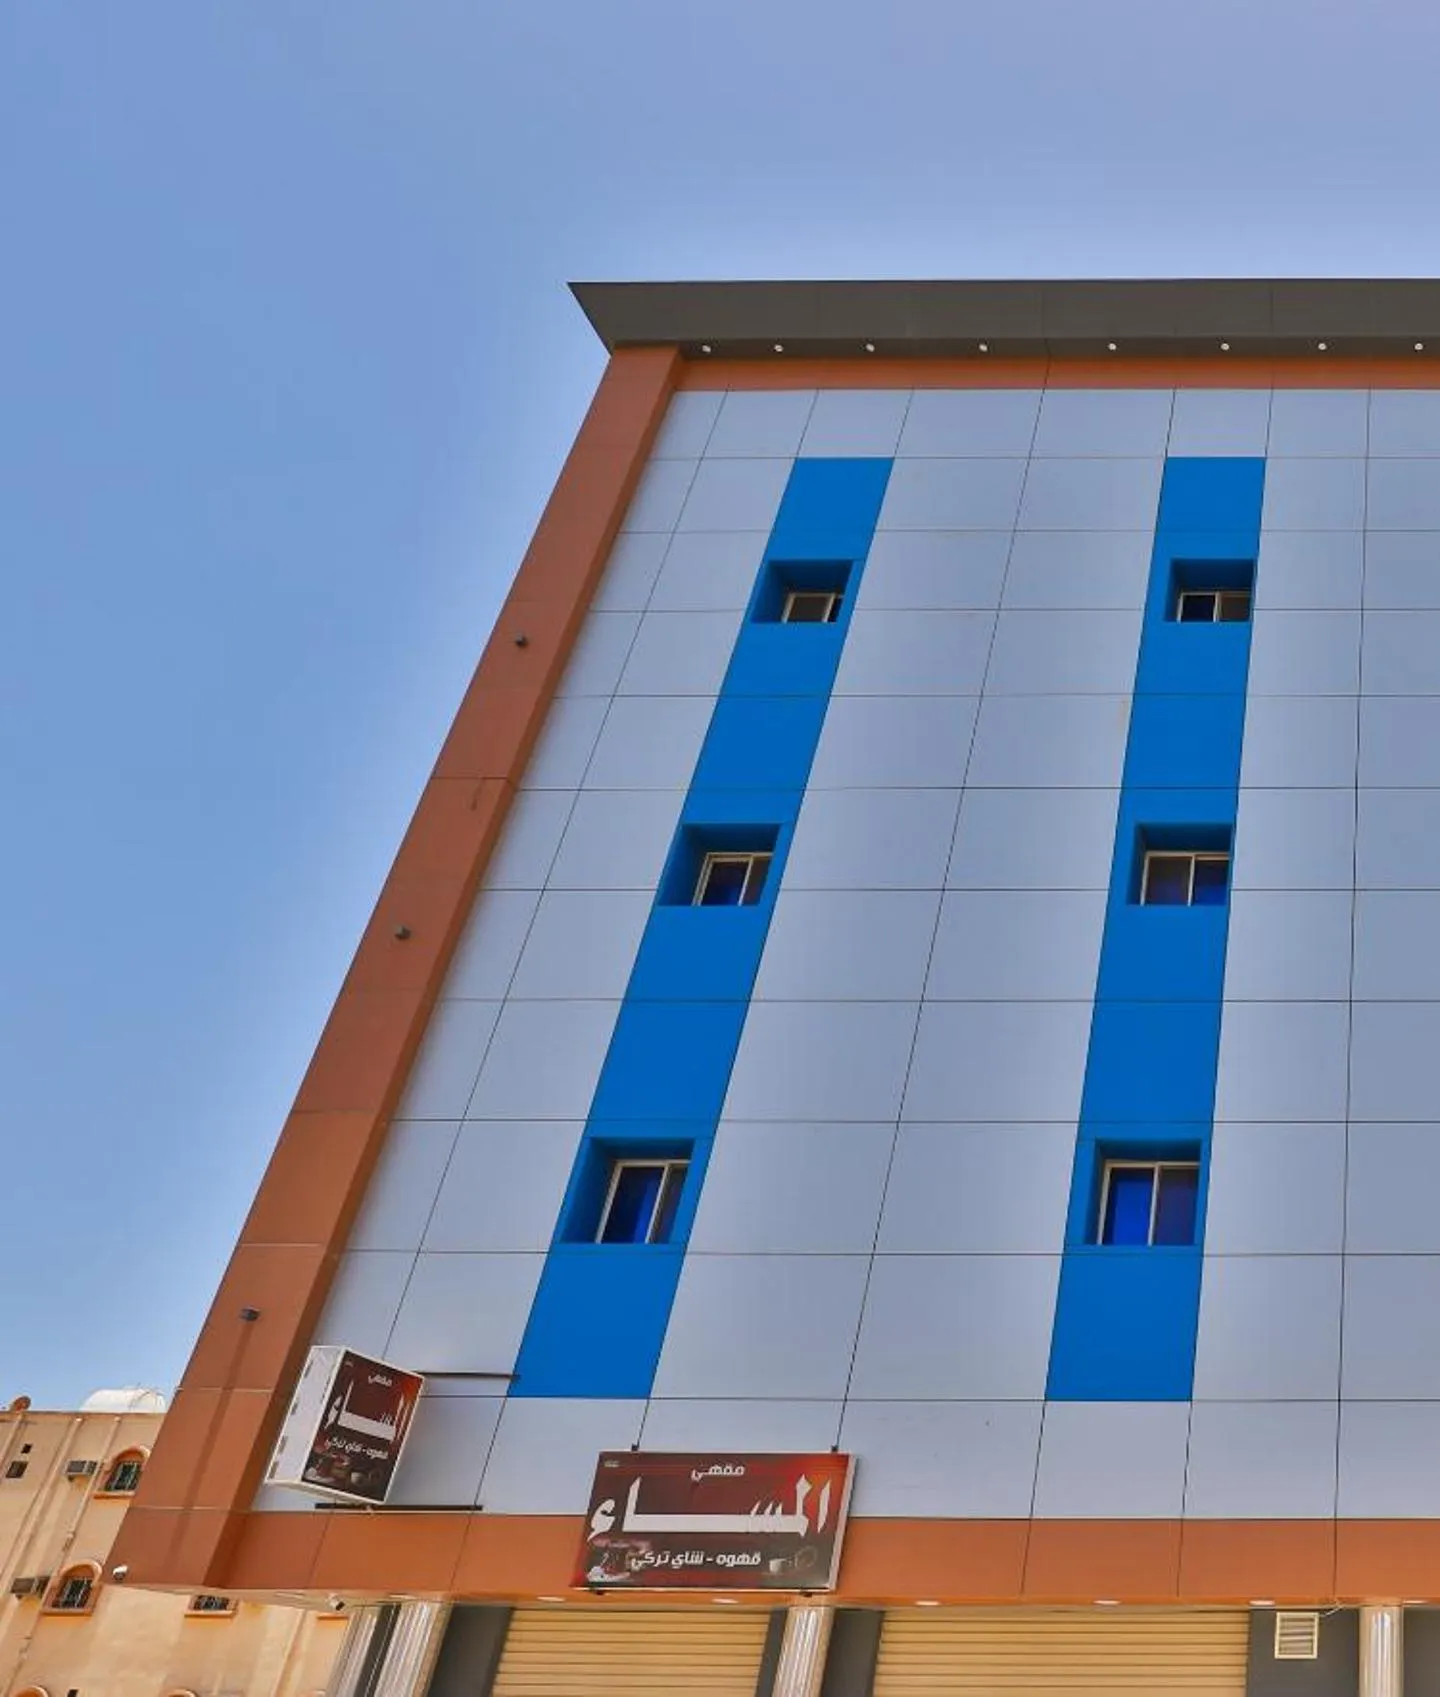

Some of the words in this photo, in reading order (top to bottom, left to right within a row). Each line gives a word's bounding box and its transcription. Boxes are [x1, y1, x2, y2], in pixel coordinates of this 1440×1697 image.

[586, 1472, 831, 1541] المساء
[630, 1550, 671, 1571] تركي
[671, 1550, 704, 1570] شاي
